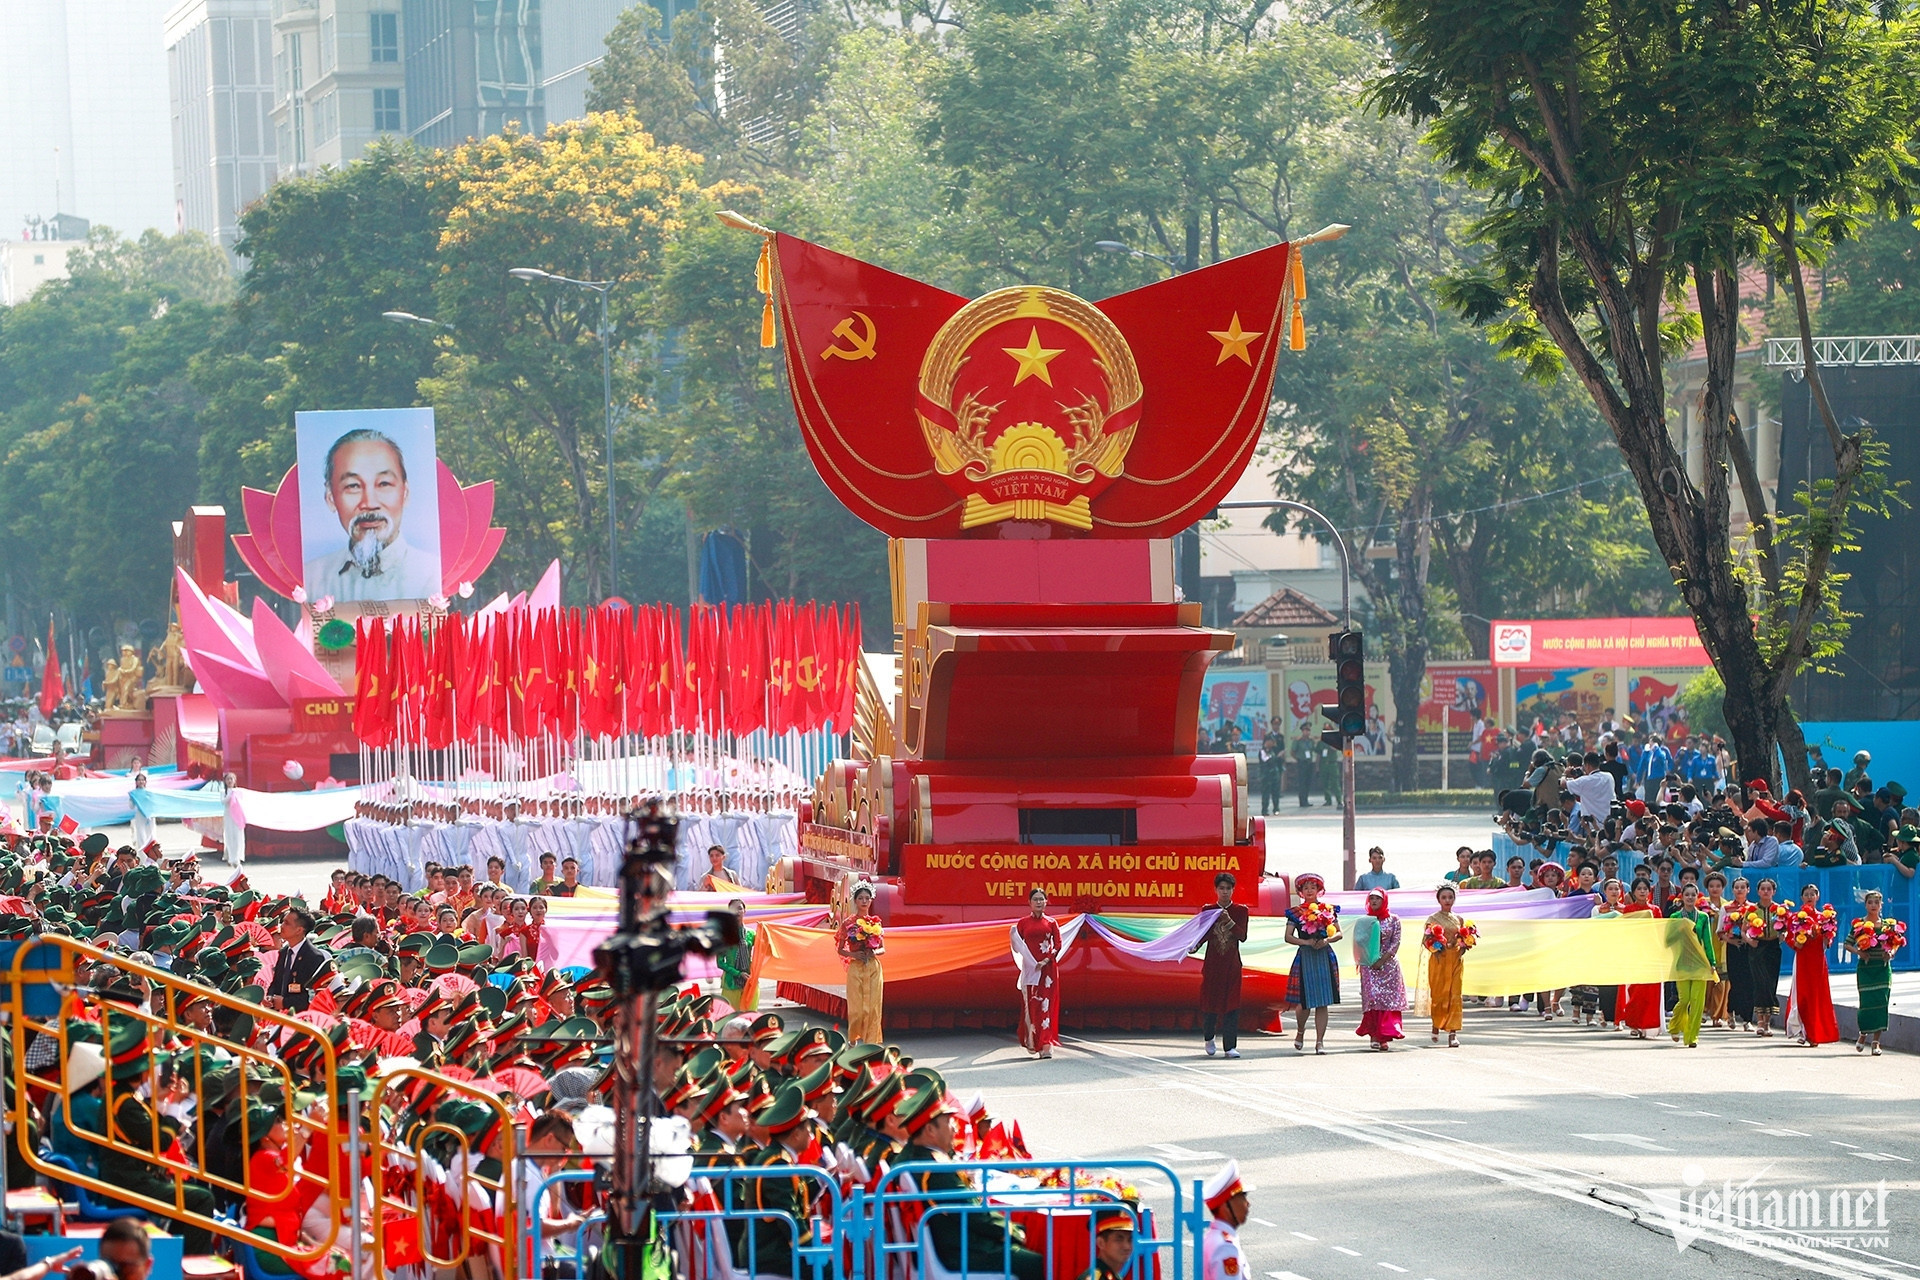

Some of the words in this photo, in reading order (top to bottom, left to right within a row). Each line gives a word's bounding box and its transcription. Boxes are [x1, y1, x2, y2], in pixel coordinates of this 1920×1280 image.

[993, 481, 1029, 498] VIỆT
[1033, 482, 1067, 499] NAM
[1542, 636, 1563, 649] NƯỚC
[1565, 636, 1585, 651] CỘNG
[1586, 635, 1602, 649] HÒA
[1603, 635, 1614, 648] XÃ
[1615, 635, 1628, 650] HỘI
[1629, 634, 1645, 648] CHỦ
[1646, 634, 1670, 648] NGHĨA
[1671, 634, 1687, 650] VIỆT
[305, 700, 339, 715] CHỦ
[926, 850, 975, 869] NƯỚC
[980, 851, 1028, 871] CỘNG
[1032, 851, 1071, 869] HÒA
[1077, 852, 1104, 870] XÃ
[1108, 852, 1140, 872] HỘI
[1145, 852, 1180, 871] CHỦ
[1184, 853, 1240, 871] NGHĨA
[985, 879, 1026, 899] VIỆT
[1076, 879, 1130, 897] MUÔN
